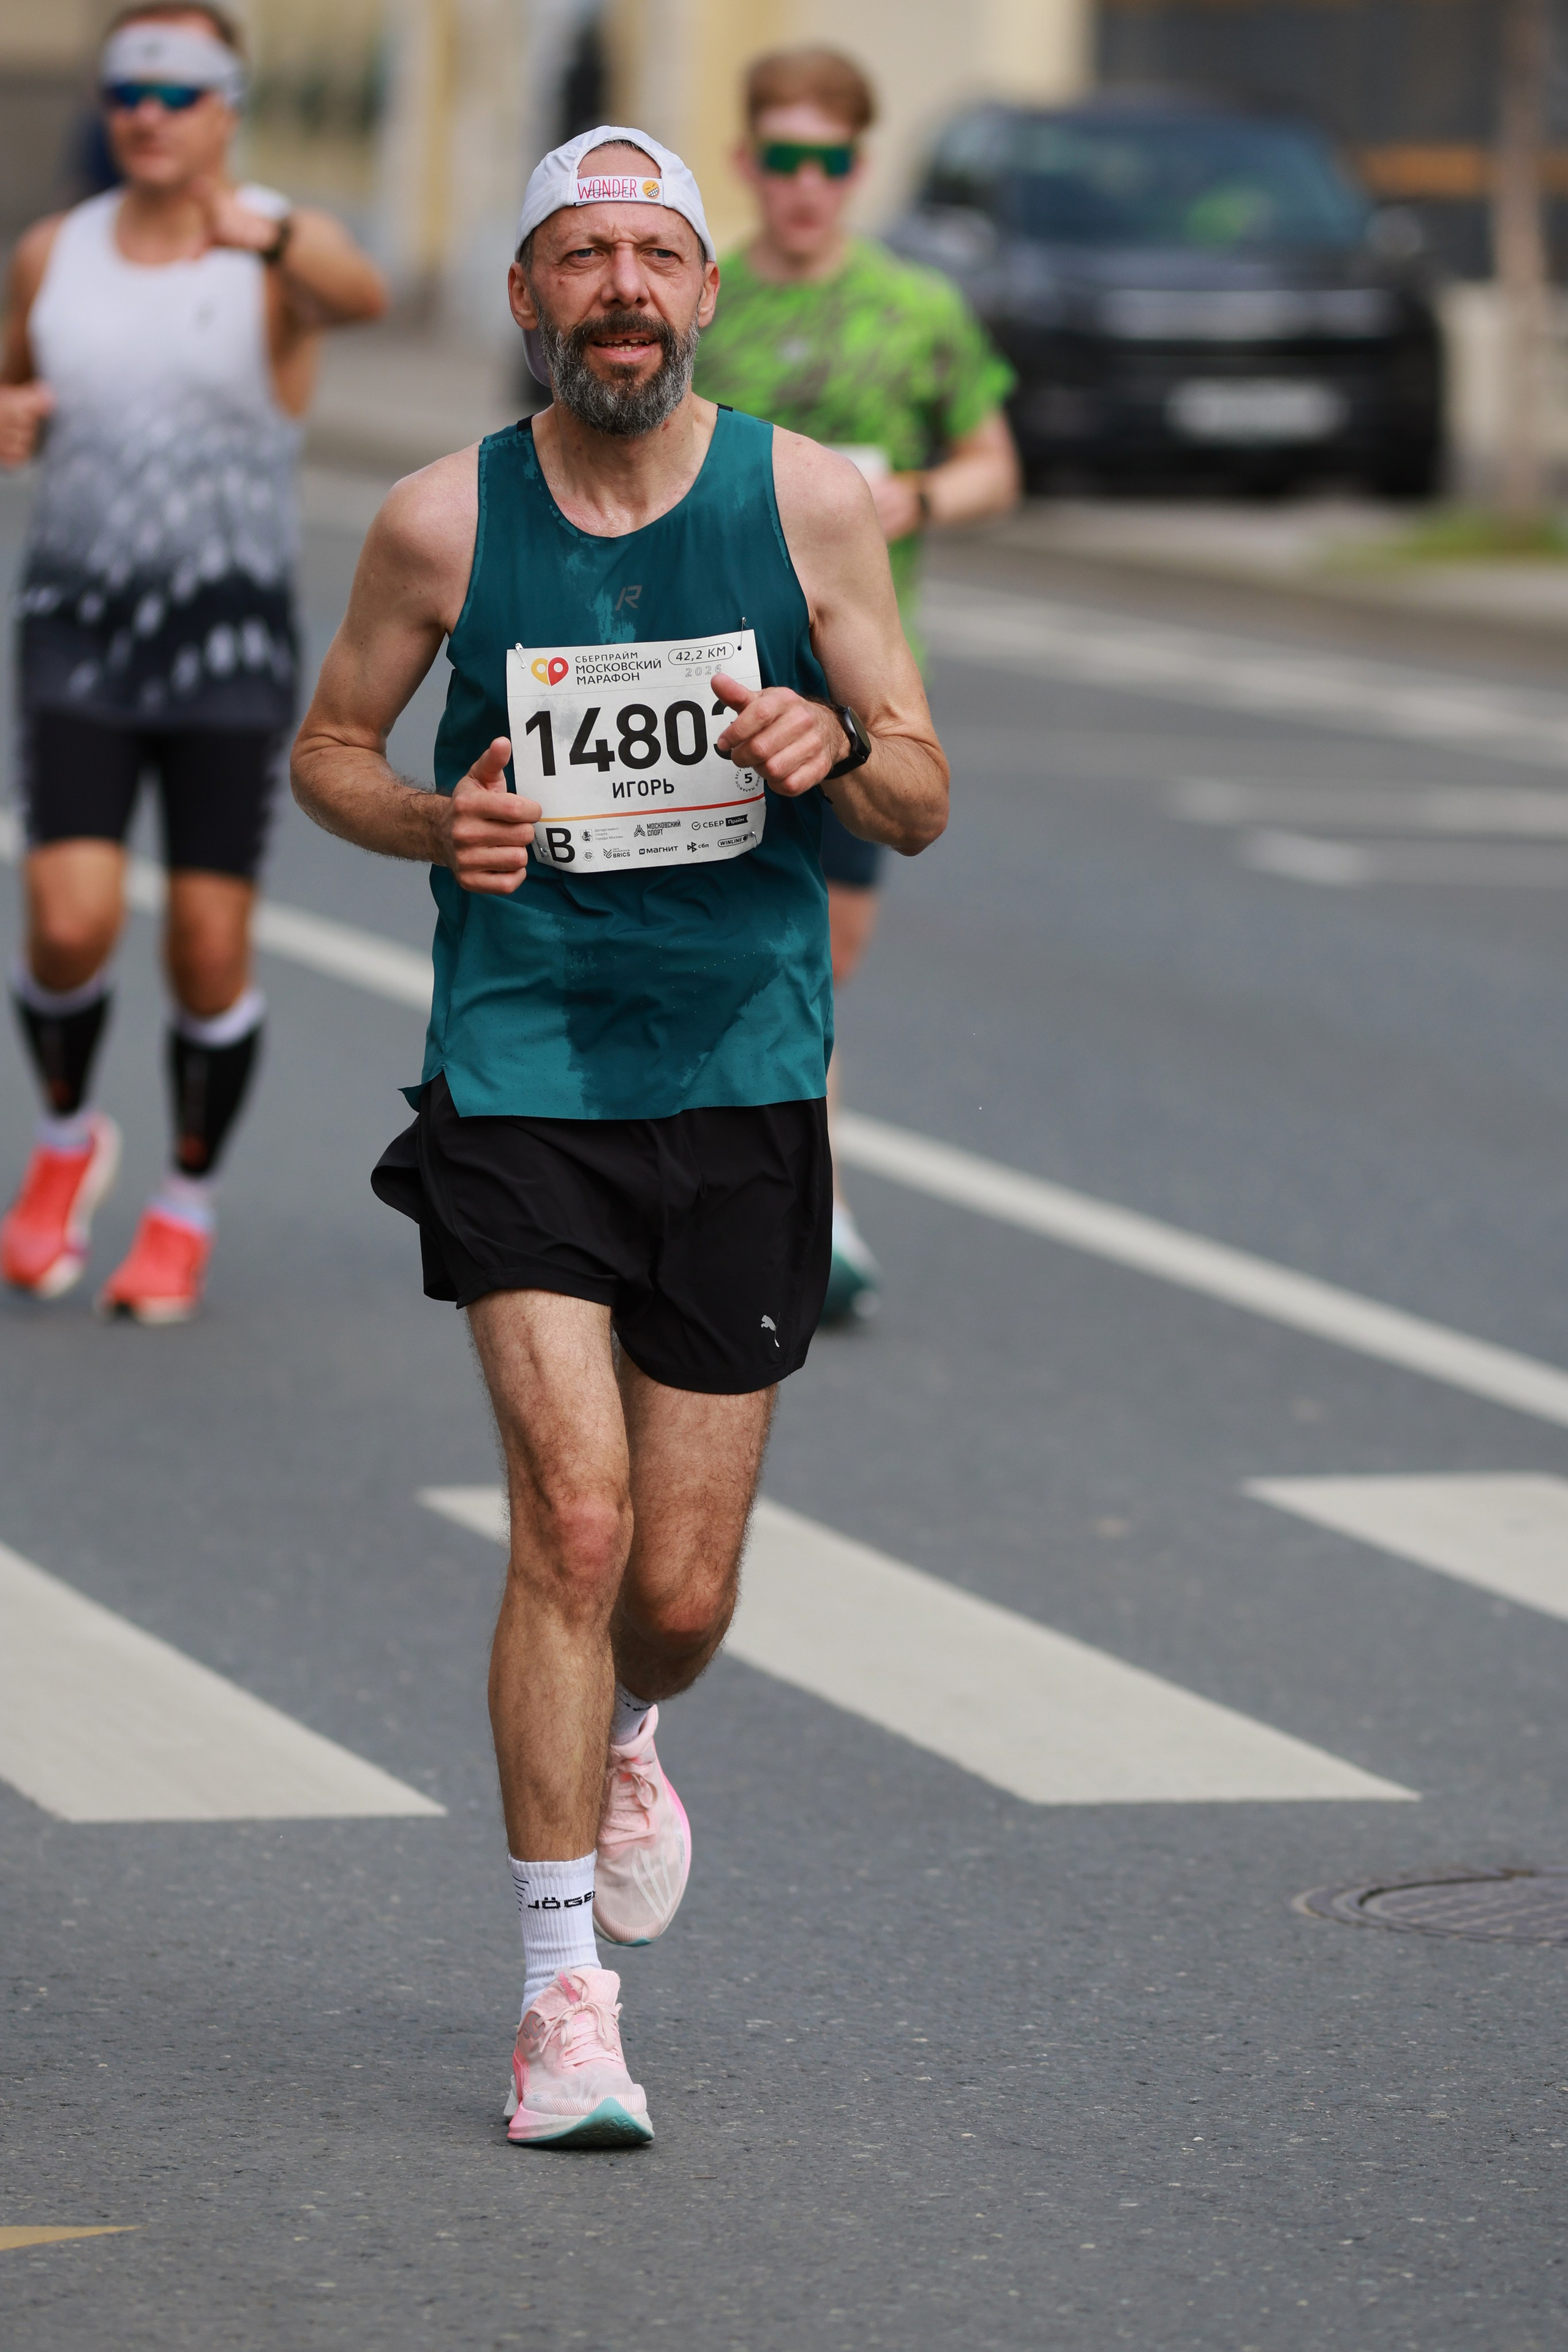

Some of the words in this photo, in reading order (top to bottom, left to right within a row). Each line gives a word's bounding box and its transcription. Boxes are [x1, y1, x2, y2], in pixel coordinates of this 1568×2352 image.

[578, 179, 637, 200] WONDER
[575, 651, 638, 663] СБЕРПРАЙМ
[676, 650, 703, 662] 42,2
[708, 646, 726, 658] КМ
[575, 658, 662, 674] МОСКОВСКИЙ
[685, 664, 722, 677] 2026
[576, 672, 640, 685] МАРАФОН
[744, 772, 753, 784] 5
[612, 778, 674, 798] ИГОРЬ
[647, 820, 680, 830] МОСКОВСКИЙ
[545, 827, 575, 863] B
[720, 837, 742, 846] WINLINE
[527, 1890, 596, 1909] JÖGE
